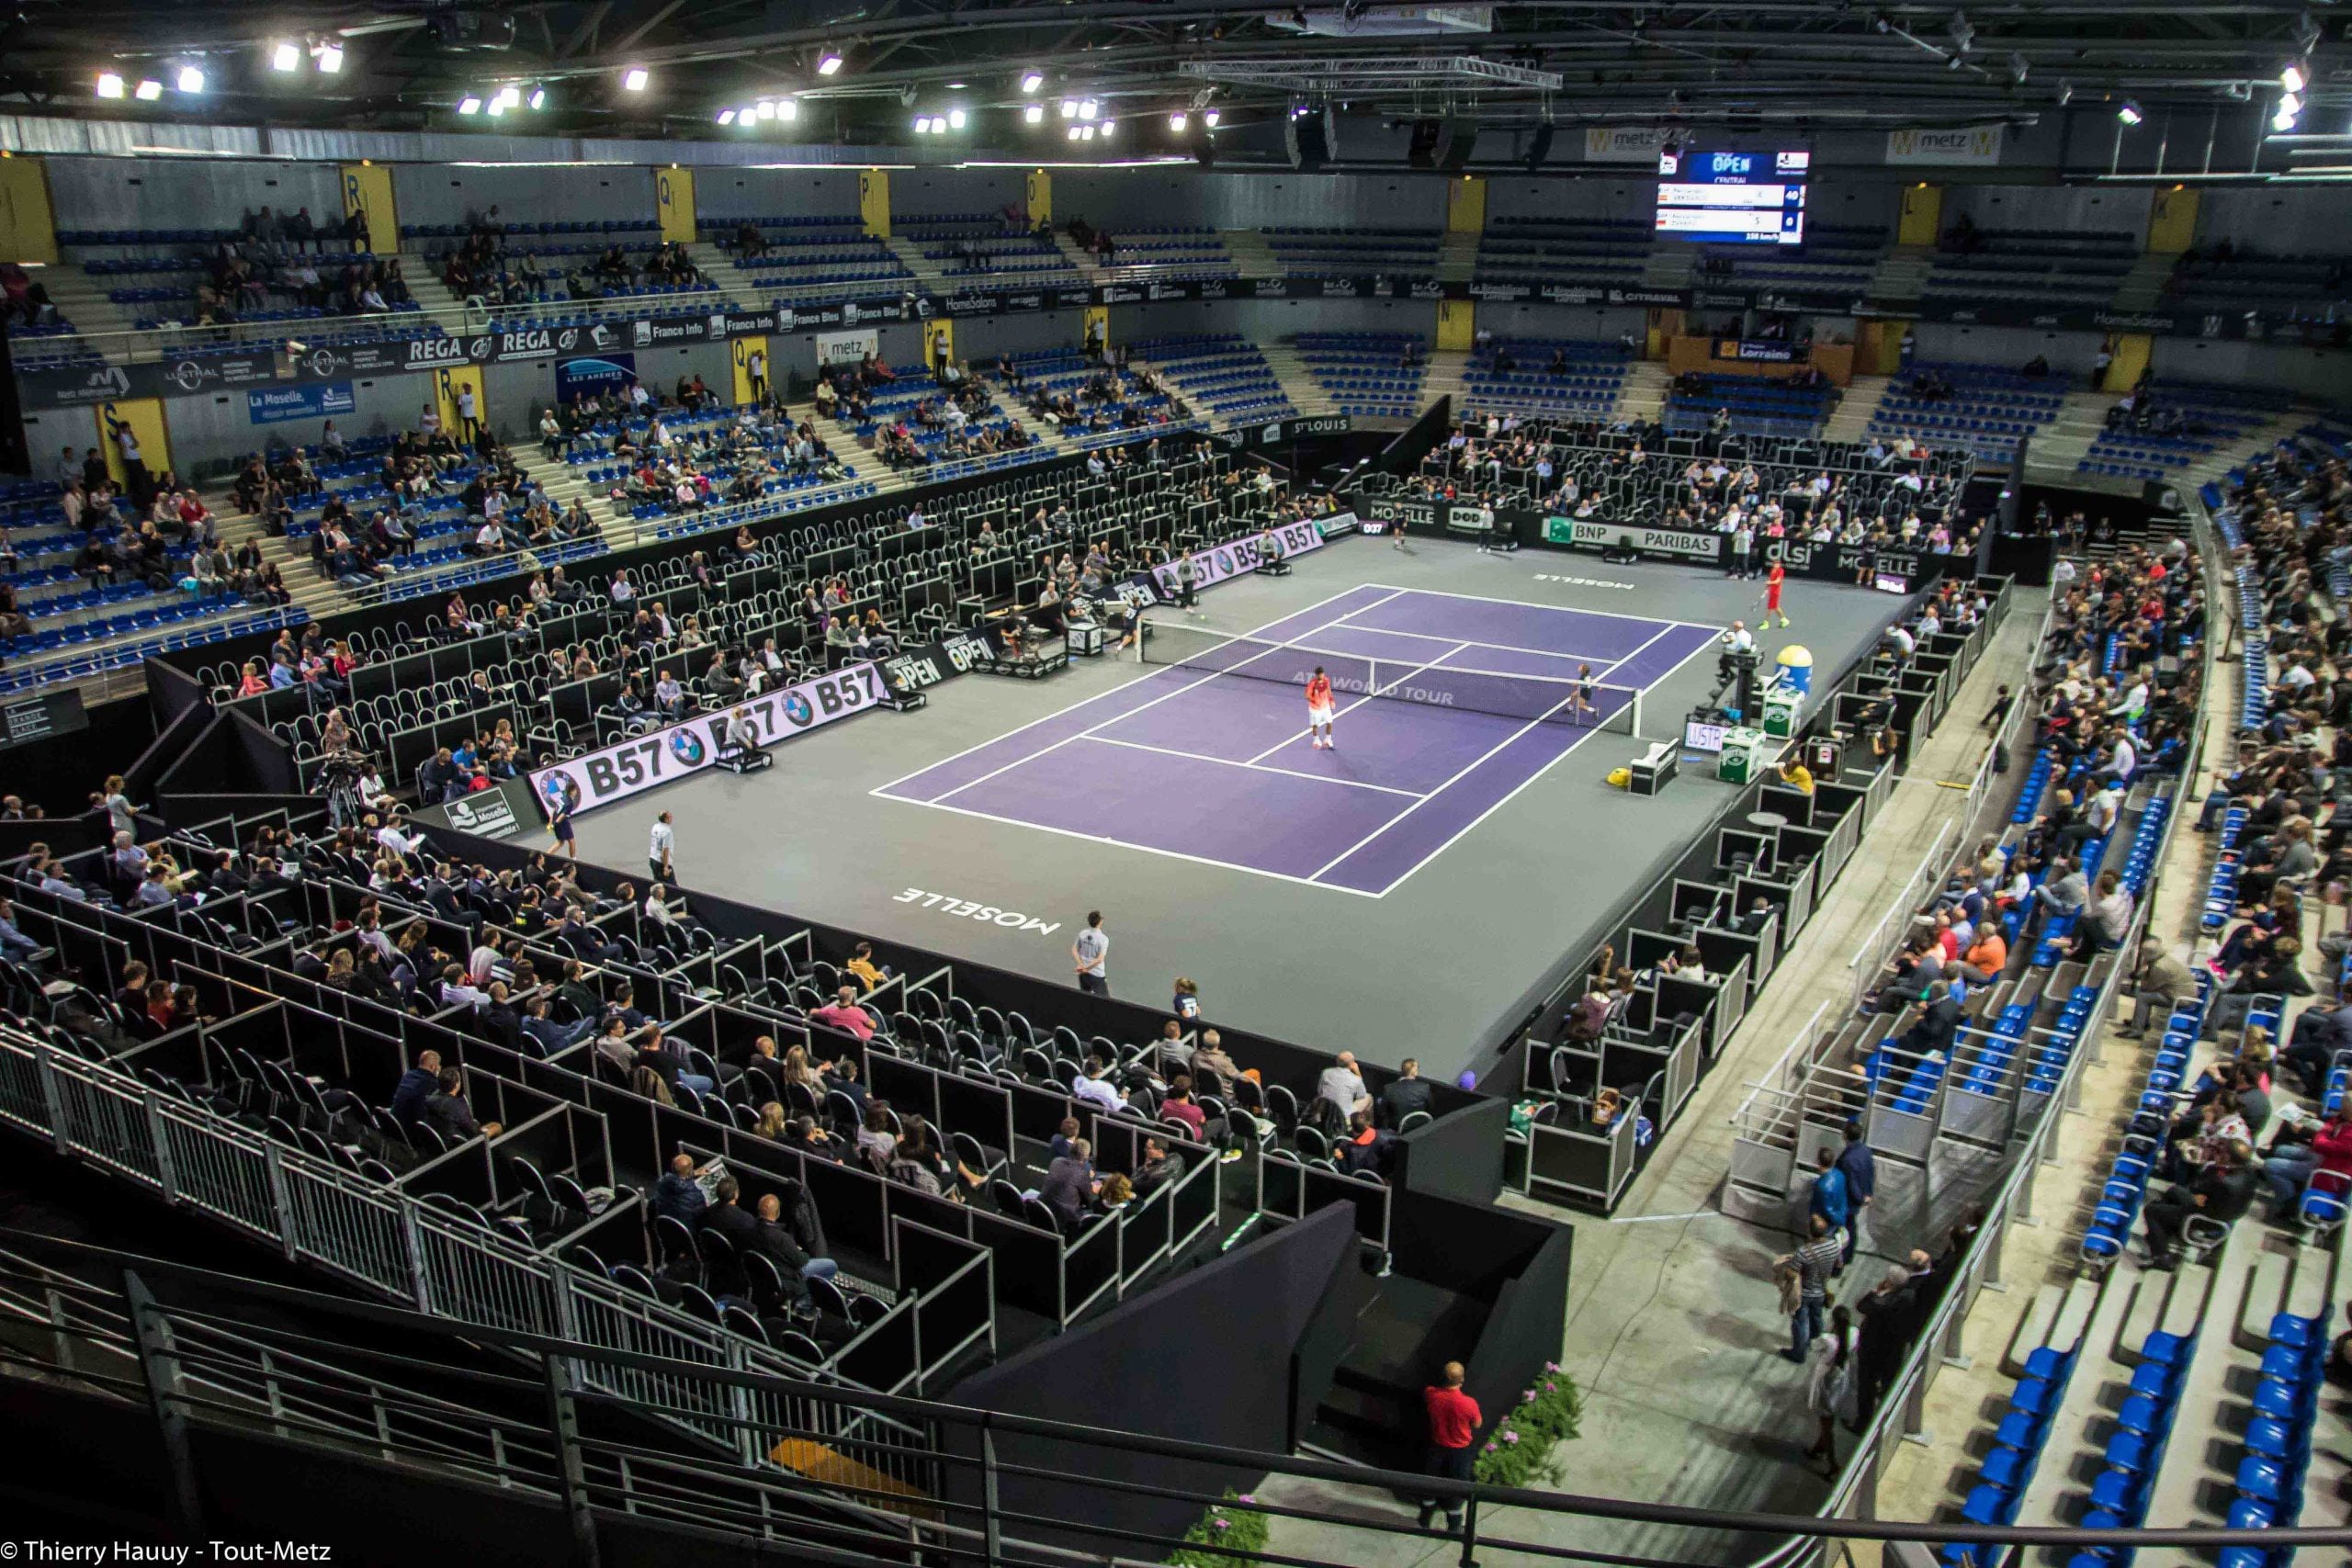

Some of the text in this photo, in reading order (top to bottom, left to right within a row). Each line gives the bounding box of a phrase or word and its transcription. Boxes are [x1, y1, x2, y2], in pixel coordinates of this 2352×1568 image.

[1614, 130, 1654, 145] metz
[1921, 132, 1966, 148] metz
[1713, 157, 1751, 173] OPEN
[347, 175, 362, 208] R
[660, 176, 671, 206] Q
[862, 177, 870, 199] P
[1785, 190, 1799, 201] 40
[794, 310, 840, 325] France Bleu
[857, 305, 900, 320] France Bleu
[653, 323, 703, 338] France Info
[727, 316, 774, 332] France Info
[411, 338, 462, 361] REGA
[503, 331, 551, 353] REGA
[832, 340, 863, 356] metz
[735, 340, 746, 368] Q
[440, 368, 453, 401] R
[249, 390, 305, 408] La Moselle,
[1307, 419, 1348, 431] LOUIS
[1370, 506, 1435, 525] MOLLE
[1452, 510, 1480, 523] DOD
[1283, 524, 1317, 551] B57
[1576, 525, 1711, 552] BNP PARIBAS
[1234, 537, 1261, 568] B5
[1767, 540, 1812, 564] dlsi
[1838, 555, 1918, 577] MOELLE
[1532, 573, 1635, 590] MOSELLE
[1118, 583, 1158, 607] OPEN
[948, 637, 995, 672] OPEN
[893, 657, 942, 692] OPEN
[816, 667, 875, 715] B57
[1334, 677, 1397, 696] WORLD
[1400, 686, 1455, 705] TOUR
[1688, 722, 1723, 747] LUSTR
[586, 739, 662, 797] B57
[477, 806, 510, 824] Moselle
[892, 887, 1062, 936] MOSELLE
